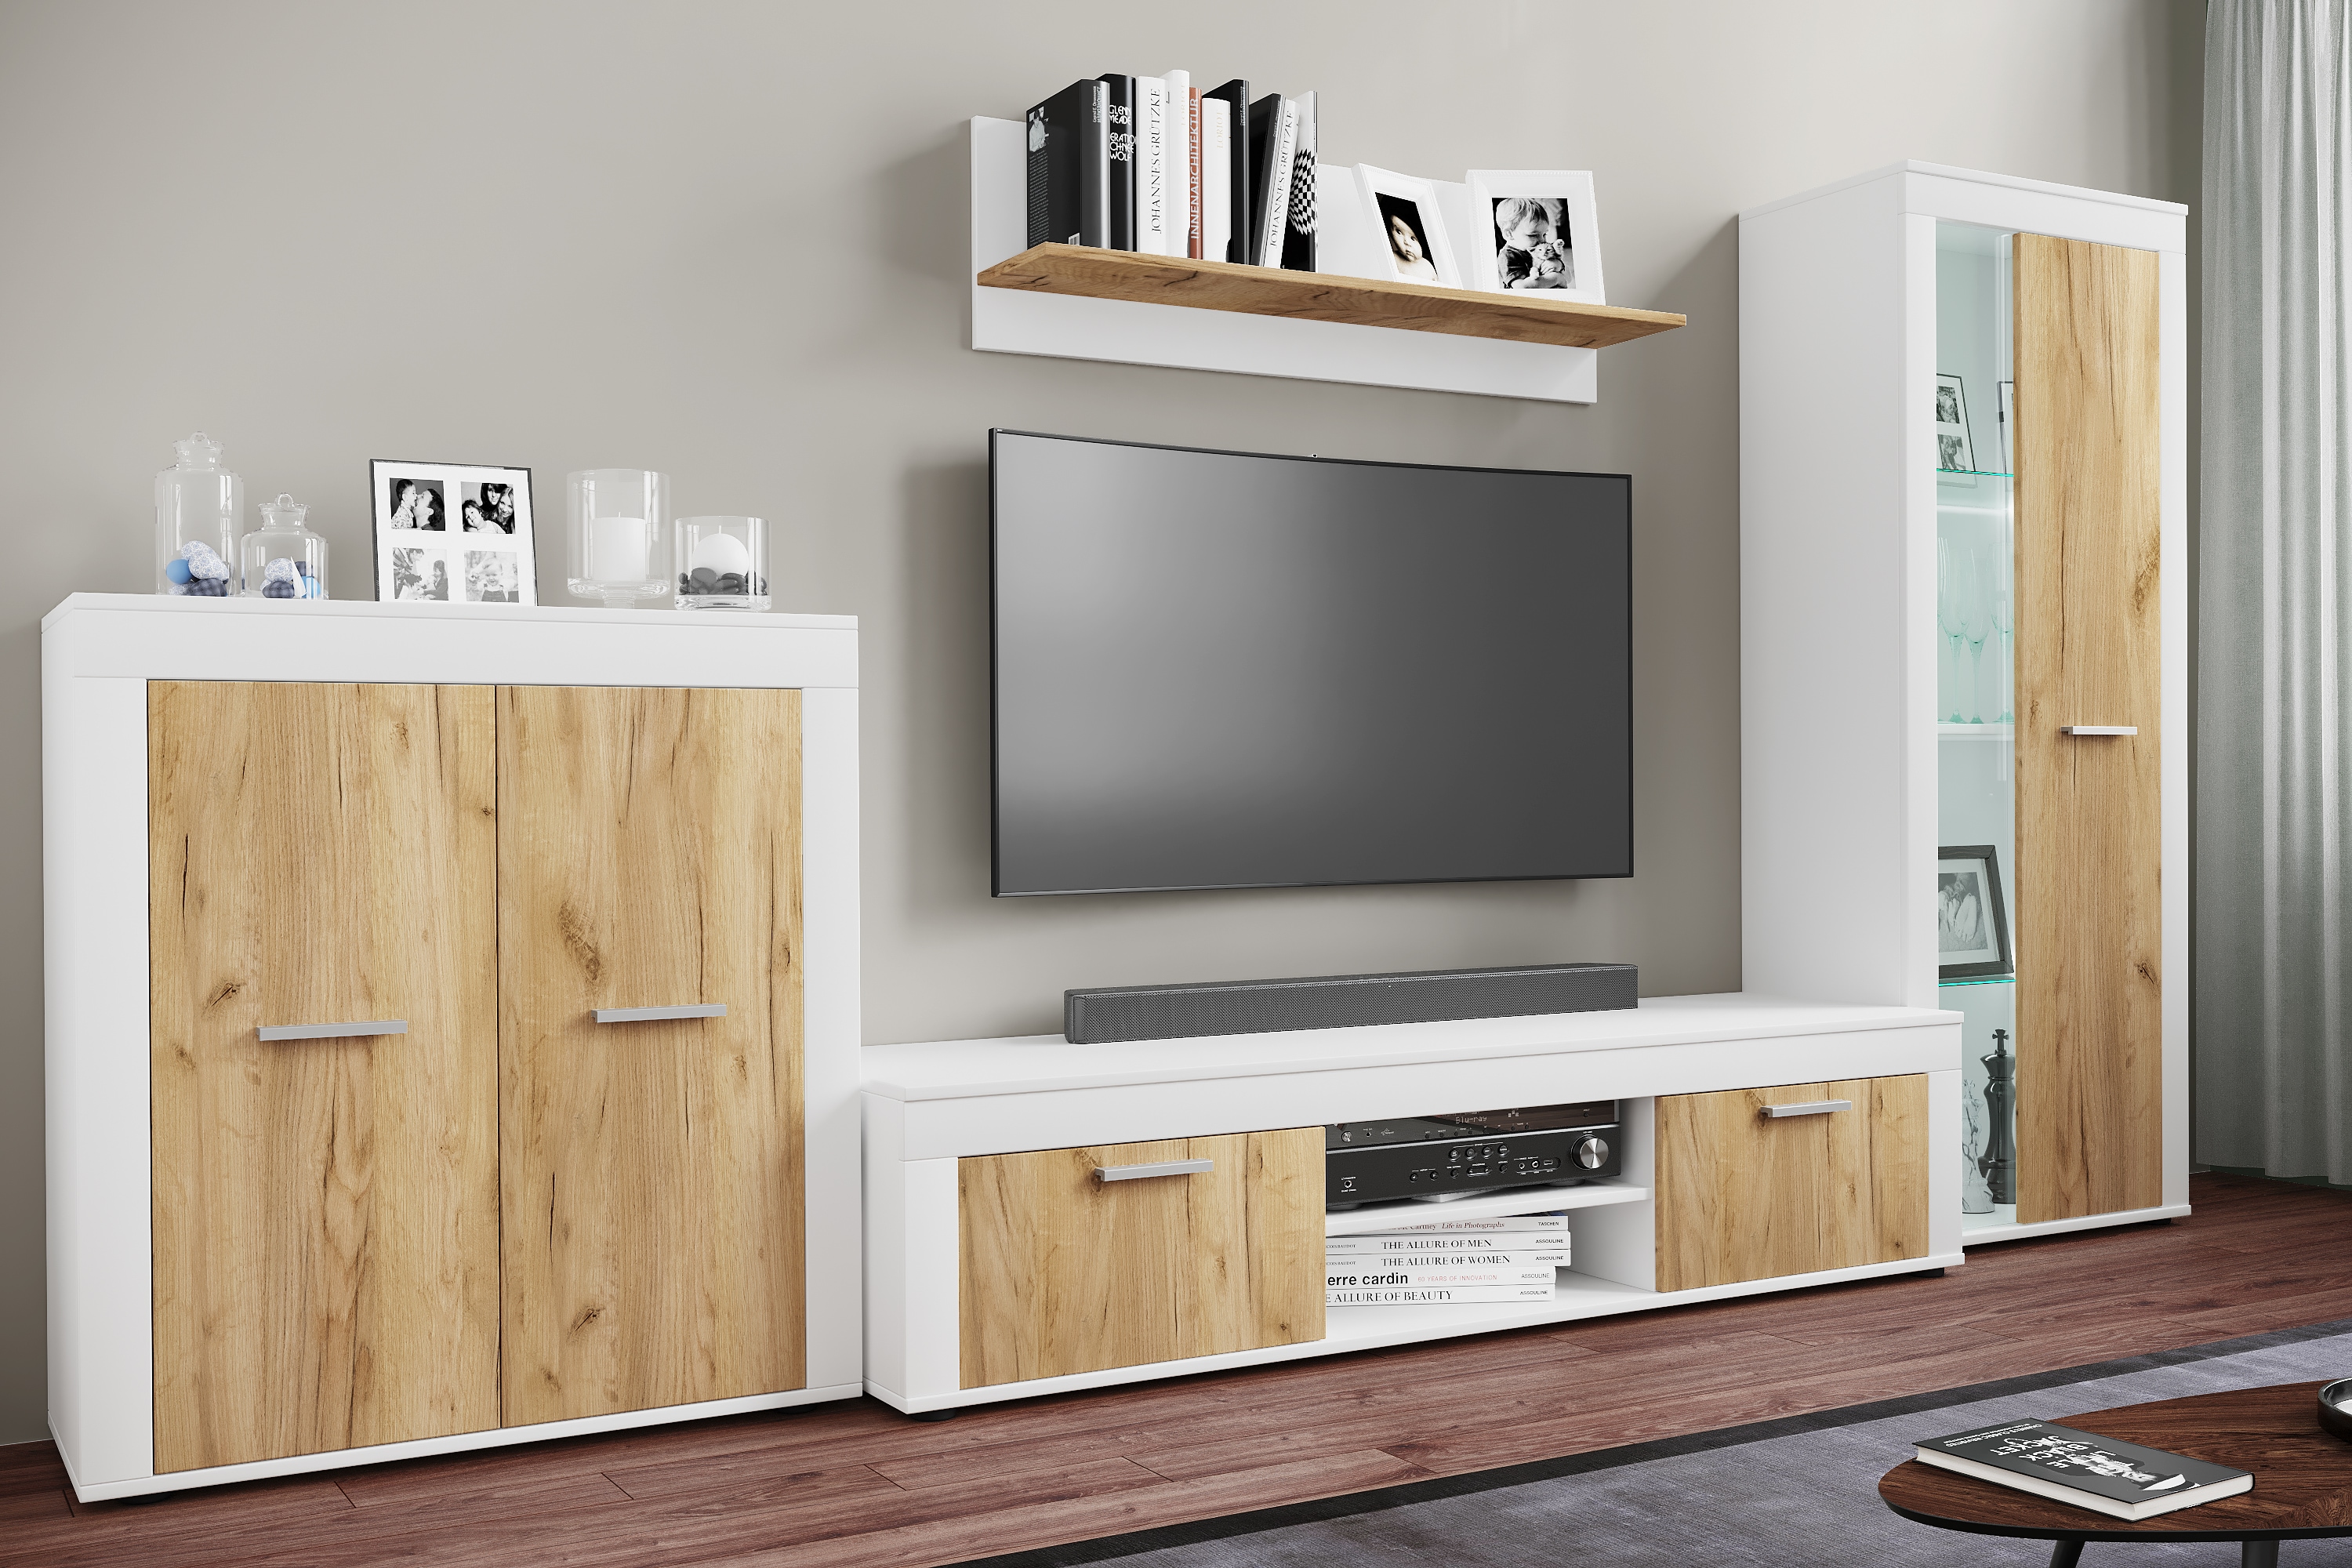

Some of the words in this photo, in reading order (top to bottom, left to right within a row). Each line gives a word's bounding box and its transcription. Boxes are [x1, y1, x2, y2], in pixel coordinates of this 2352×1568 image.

[1109, 104, 1131, 115] GLENN
[1109, 114, 1131, 125] MEADE
[1150, 89, 1160, 156] GRÜTZKE
[1109, 151, 1131, 162] WOLF
[1190, 98, 1199, 239] INNENARCHITEKTUR
[1269, 176, 1285, 247] JOHANNES
[1279, 111, 1292, 176] GRÜTZKE
[1151, 158, 1161, 234] JOHANNES
[1381, 1241, 1404, 1250] THE
[1406, 1240, 1449, 1249] ALLURE
[1450, 1240, 1465, 1248] OF
[1468, 1239, 1492, 1247] MEN
[1406, 1258, 1449, 1266] ALLURE
[1451, 1256, 1465, 1265] OF
[1468, 1255, 1511, 1264] WOMEN
[1362, 1272, 1408, 1285] cardin
[1334, 1292, 1381, 1302] ALLURE
[1385, 1291, 1400, 1301] OF
[1403, 1290, 1453, 1301] BEAUTY
